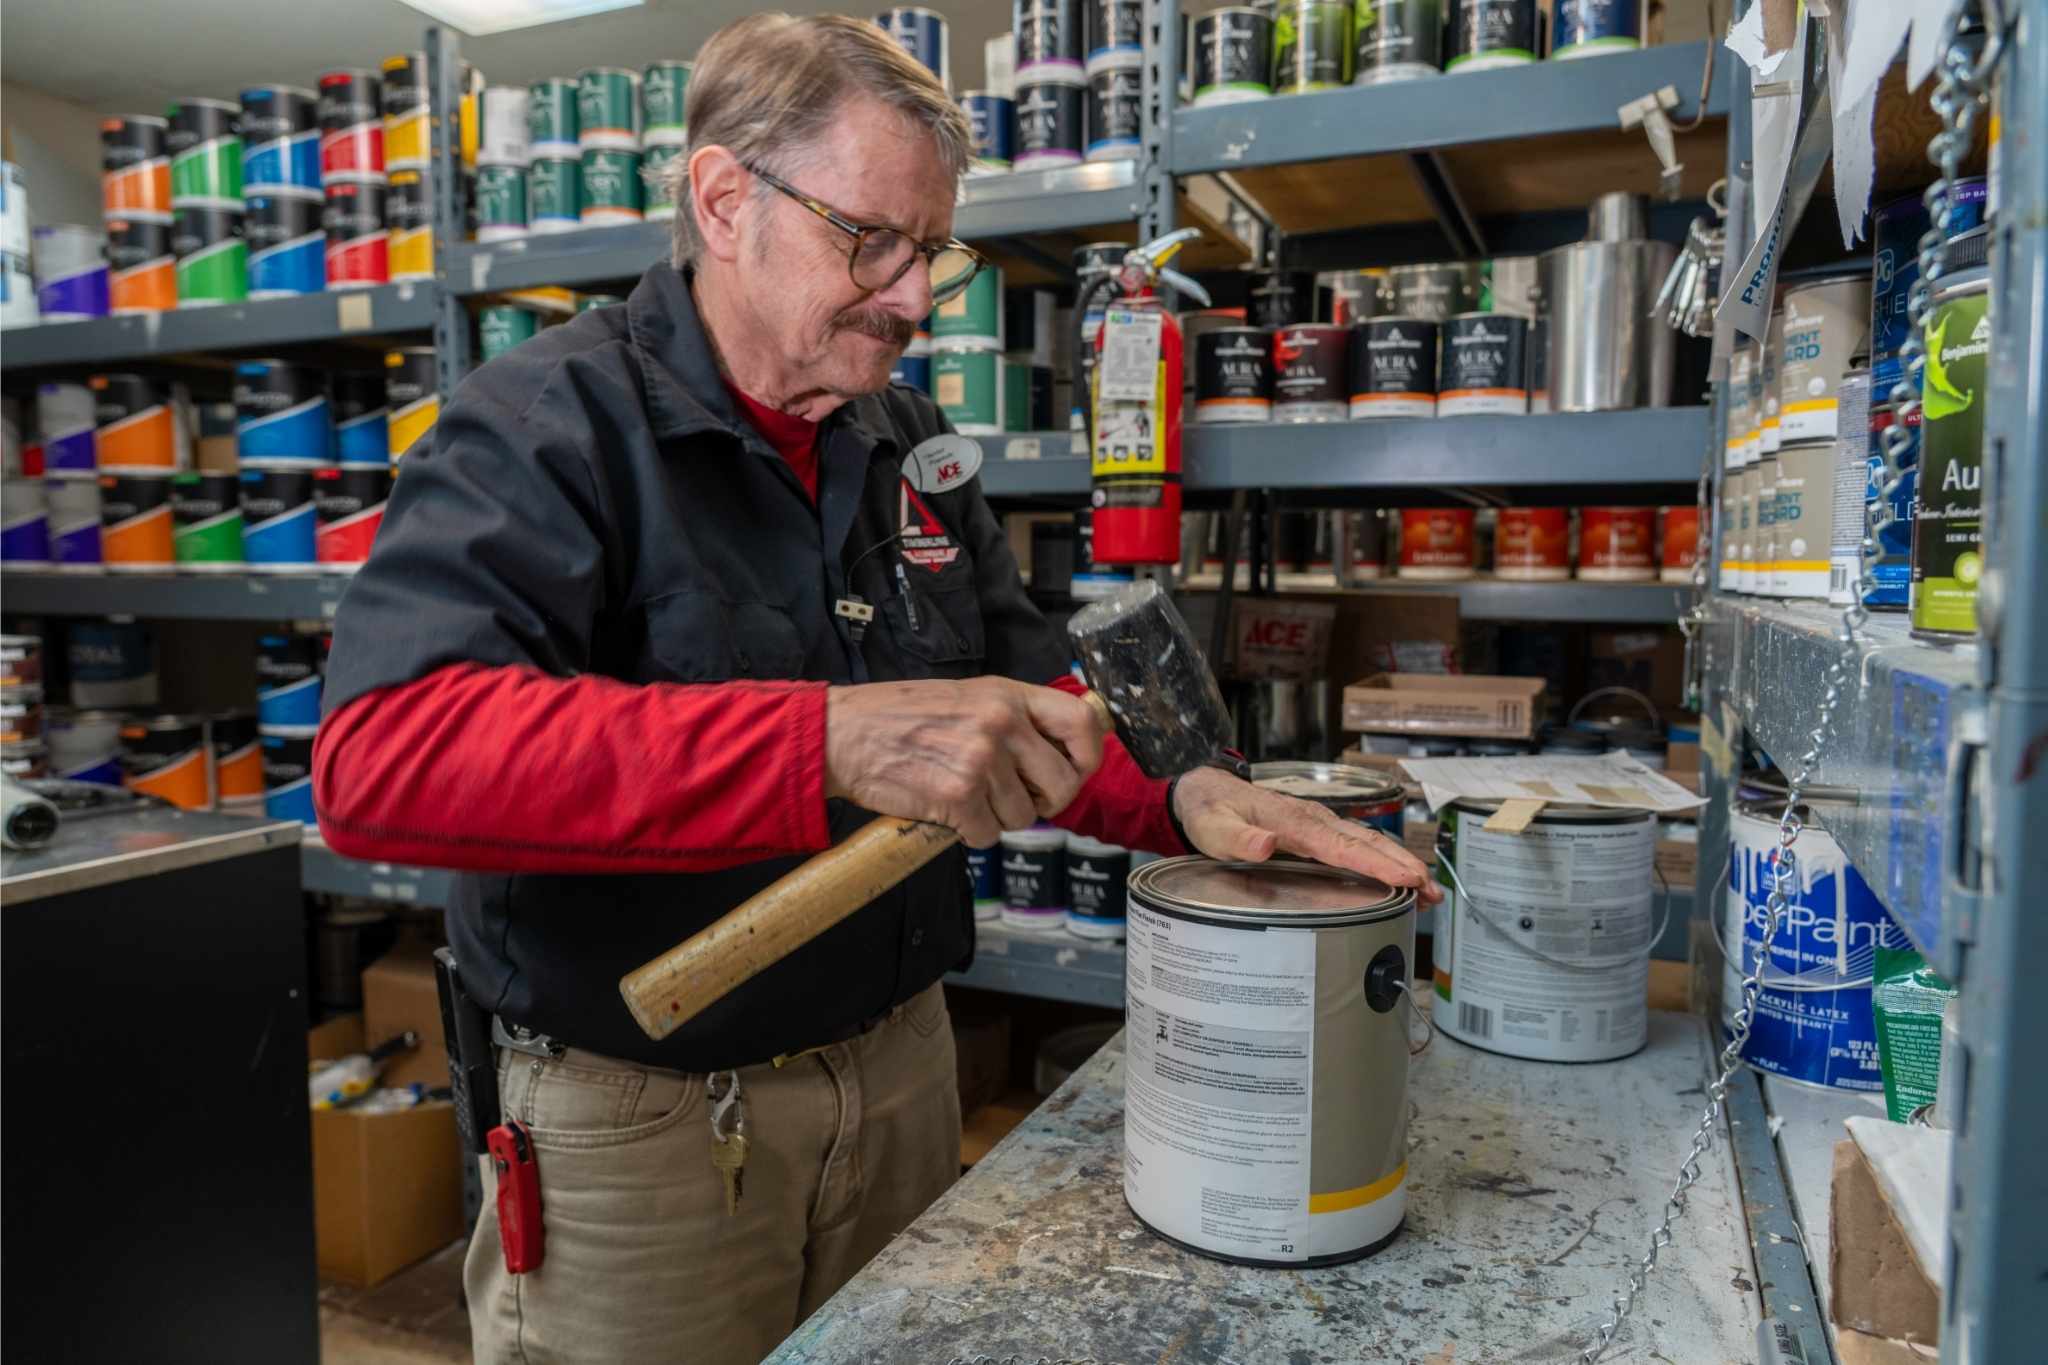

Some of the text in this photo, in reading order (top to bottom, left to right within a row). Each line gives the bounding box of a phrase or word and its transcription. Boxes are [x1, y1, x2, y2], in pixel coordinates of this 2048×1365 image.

[1372, 355, 1418, 371] AURA
[1456, 350, 1504, 367] AURA
[1784, 343, 1821, 363] ARD
[937, 461, 961, 482] ACE
[1942, 458, 1980, 491] Au
[1245, 618, 1311, 646] ACE
[1744, 902, 1894, 949] perPaint
[1759, 994, 1849, 1020] ACRYLIC LATEX
[1785, 1015, 1834, 1031] WARRANTY
[1758, 1057, 1779, 1071] FLAT
[1281, 1244, 1294, 1253] R2
